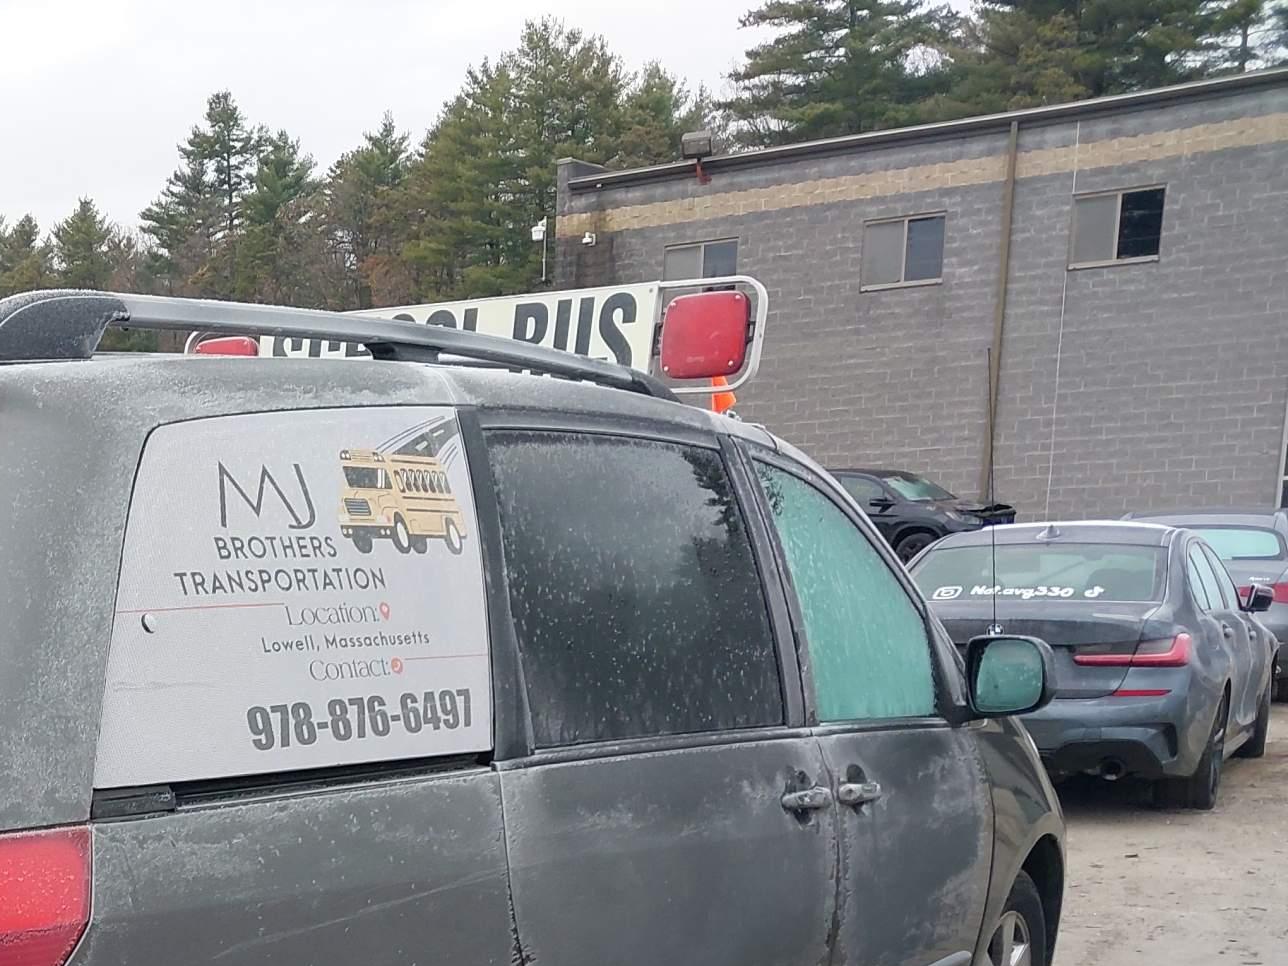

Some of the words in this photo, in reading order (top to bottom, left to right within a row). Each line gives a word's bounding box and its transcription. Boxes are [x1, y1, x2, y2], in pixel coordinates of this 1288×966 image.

[217, 460, 317, 530] MJ
[214, 535, 338, 561] BROTHERS
[174, 567, 387, 596] TRANSPORTATION
[285, 602, 381, 626] Location:
[261, 636, 321, 654] Lowell,
[324, 631, 430, 650] Massachusetts
[308, 658, 391, 682] Contact:
[246, 688, 472, 752] 978-876-6497
